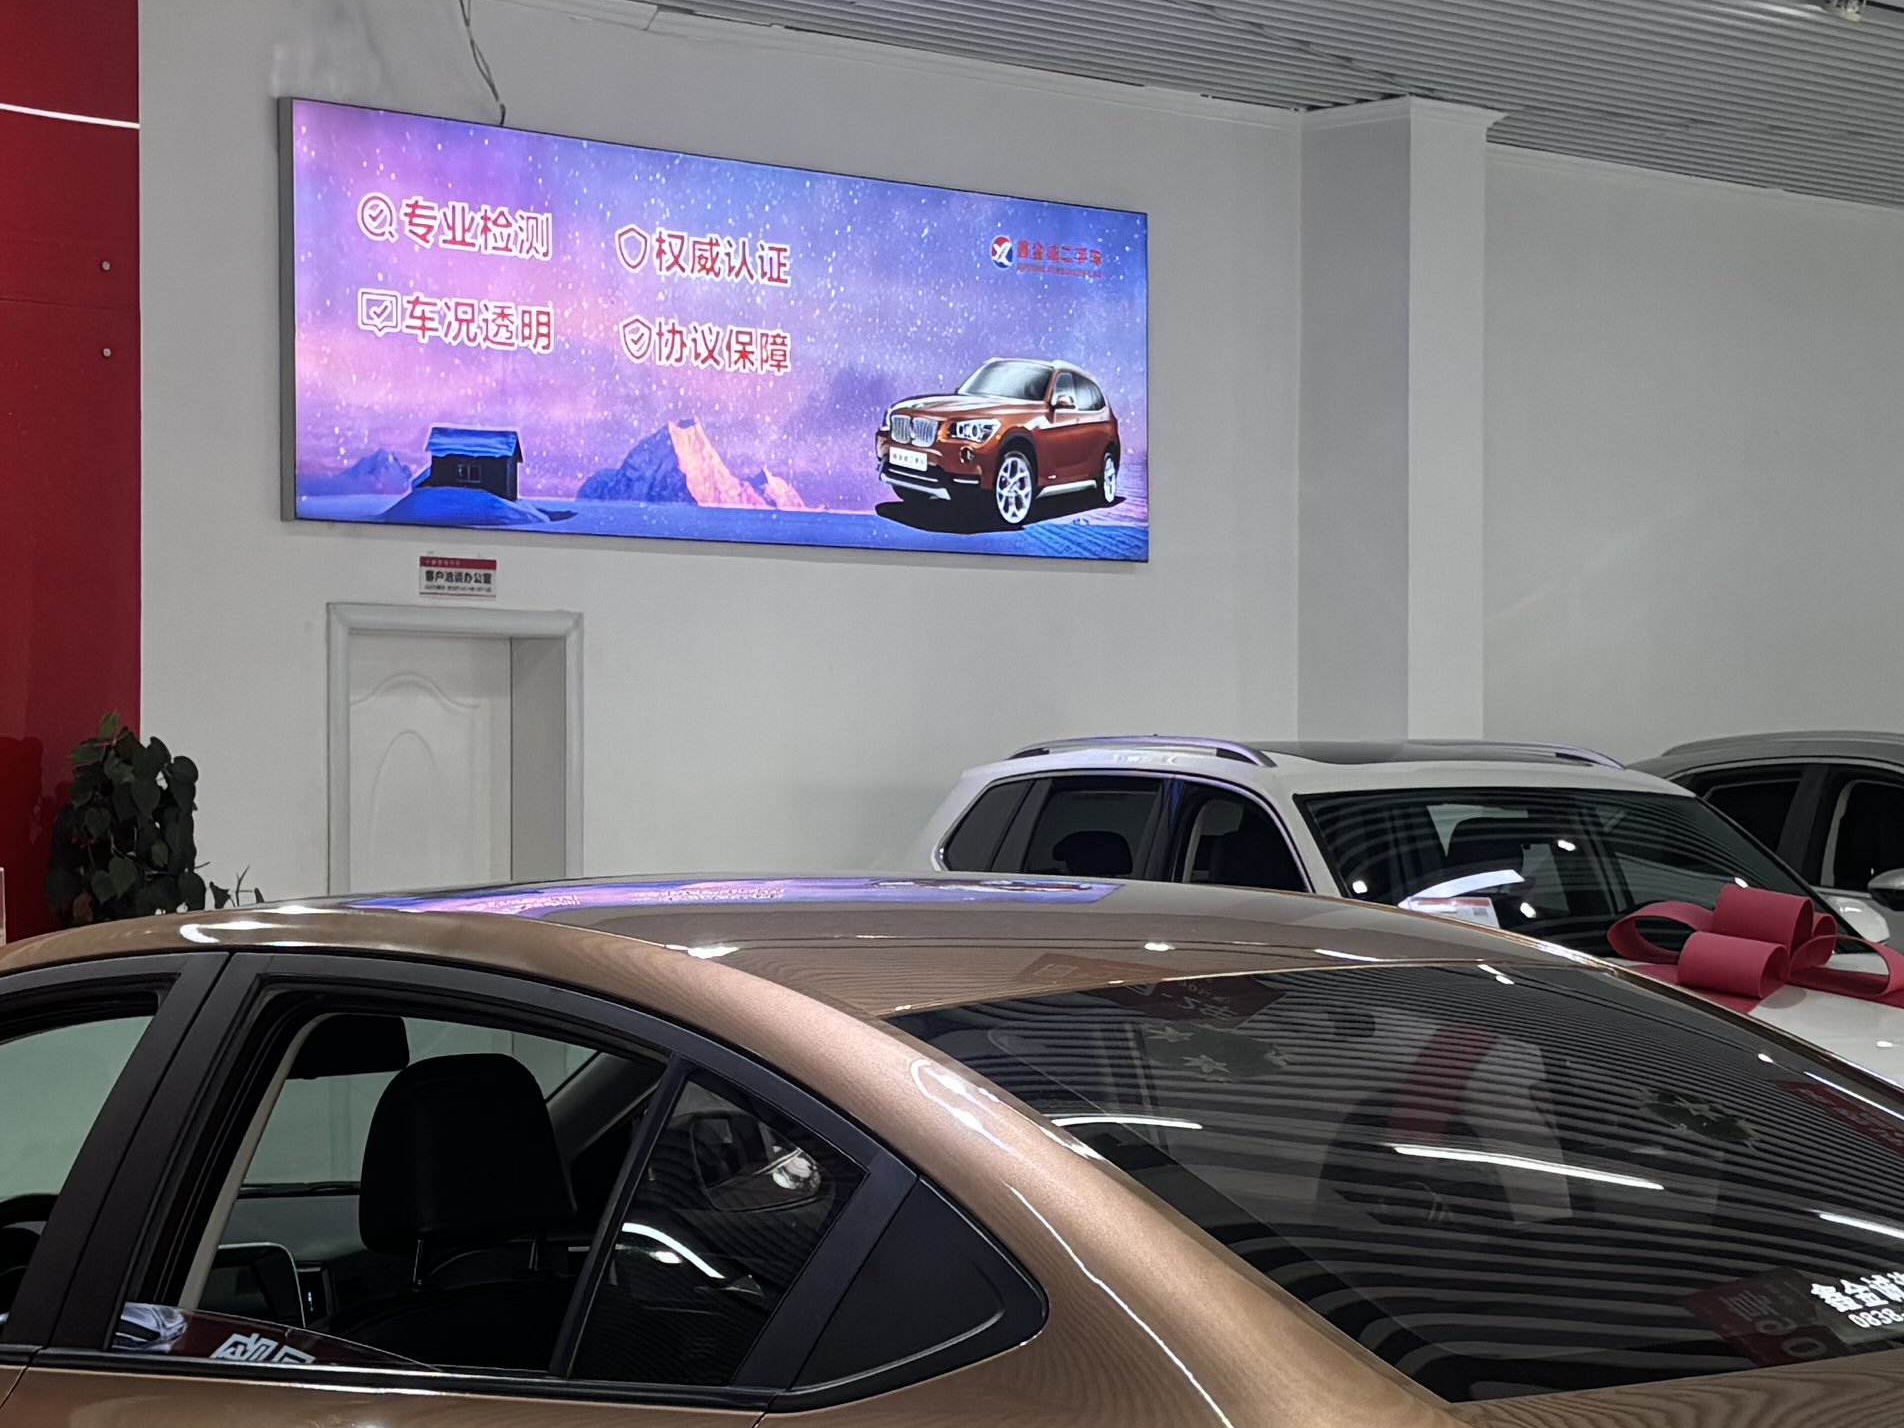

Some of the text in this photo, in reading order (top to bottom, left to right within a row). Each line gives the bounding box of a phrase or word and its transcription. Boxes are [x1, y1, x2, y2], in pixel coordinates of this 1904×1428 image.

[401, 194, 791, 287] 专业检测 权威认证
[401, 293, 793, 375] 车况透明 协议保障
